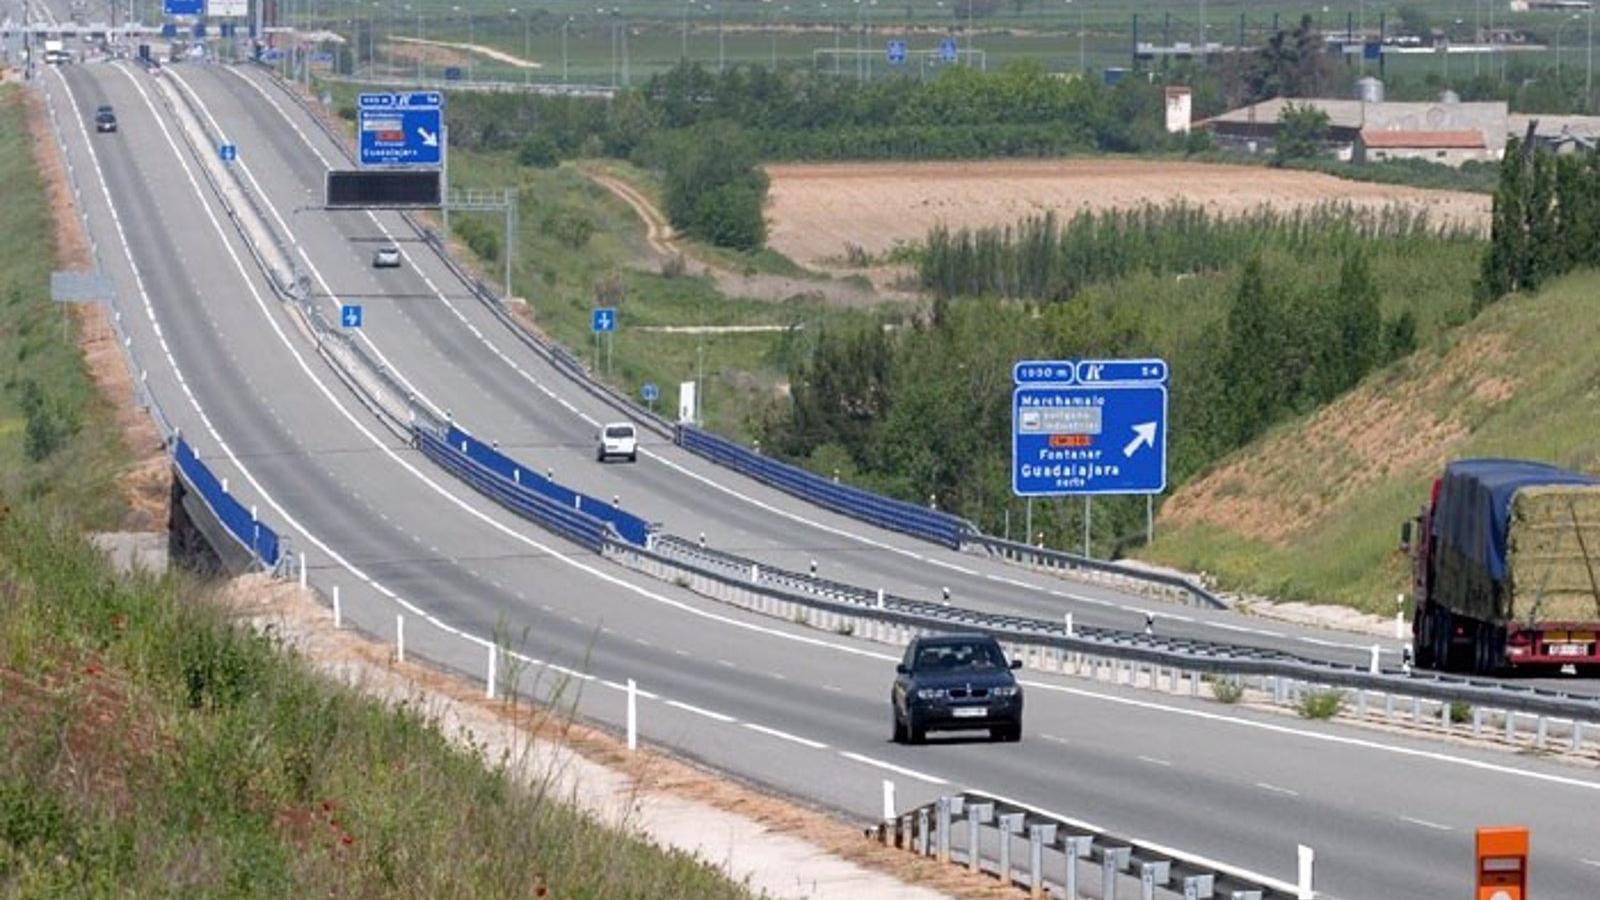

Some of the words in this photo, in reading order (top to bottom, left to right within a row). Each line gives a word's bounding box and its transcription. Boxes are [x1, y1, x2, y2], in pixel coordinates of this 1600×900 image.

[1021, 396, 1105, 406] Marchamalo
[1039, 448, 1102, 460] Fontanar
[1021, 463, 1120, 480] Guadalajara
